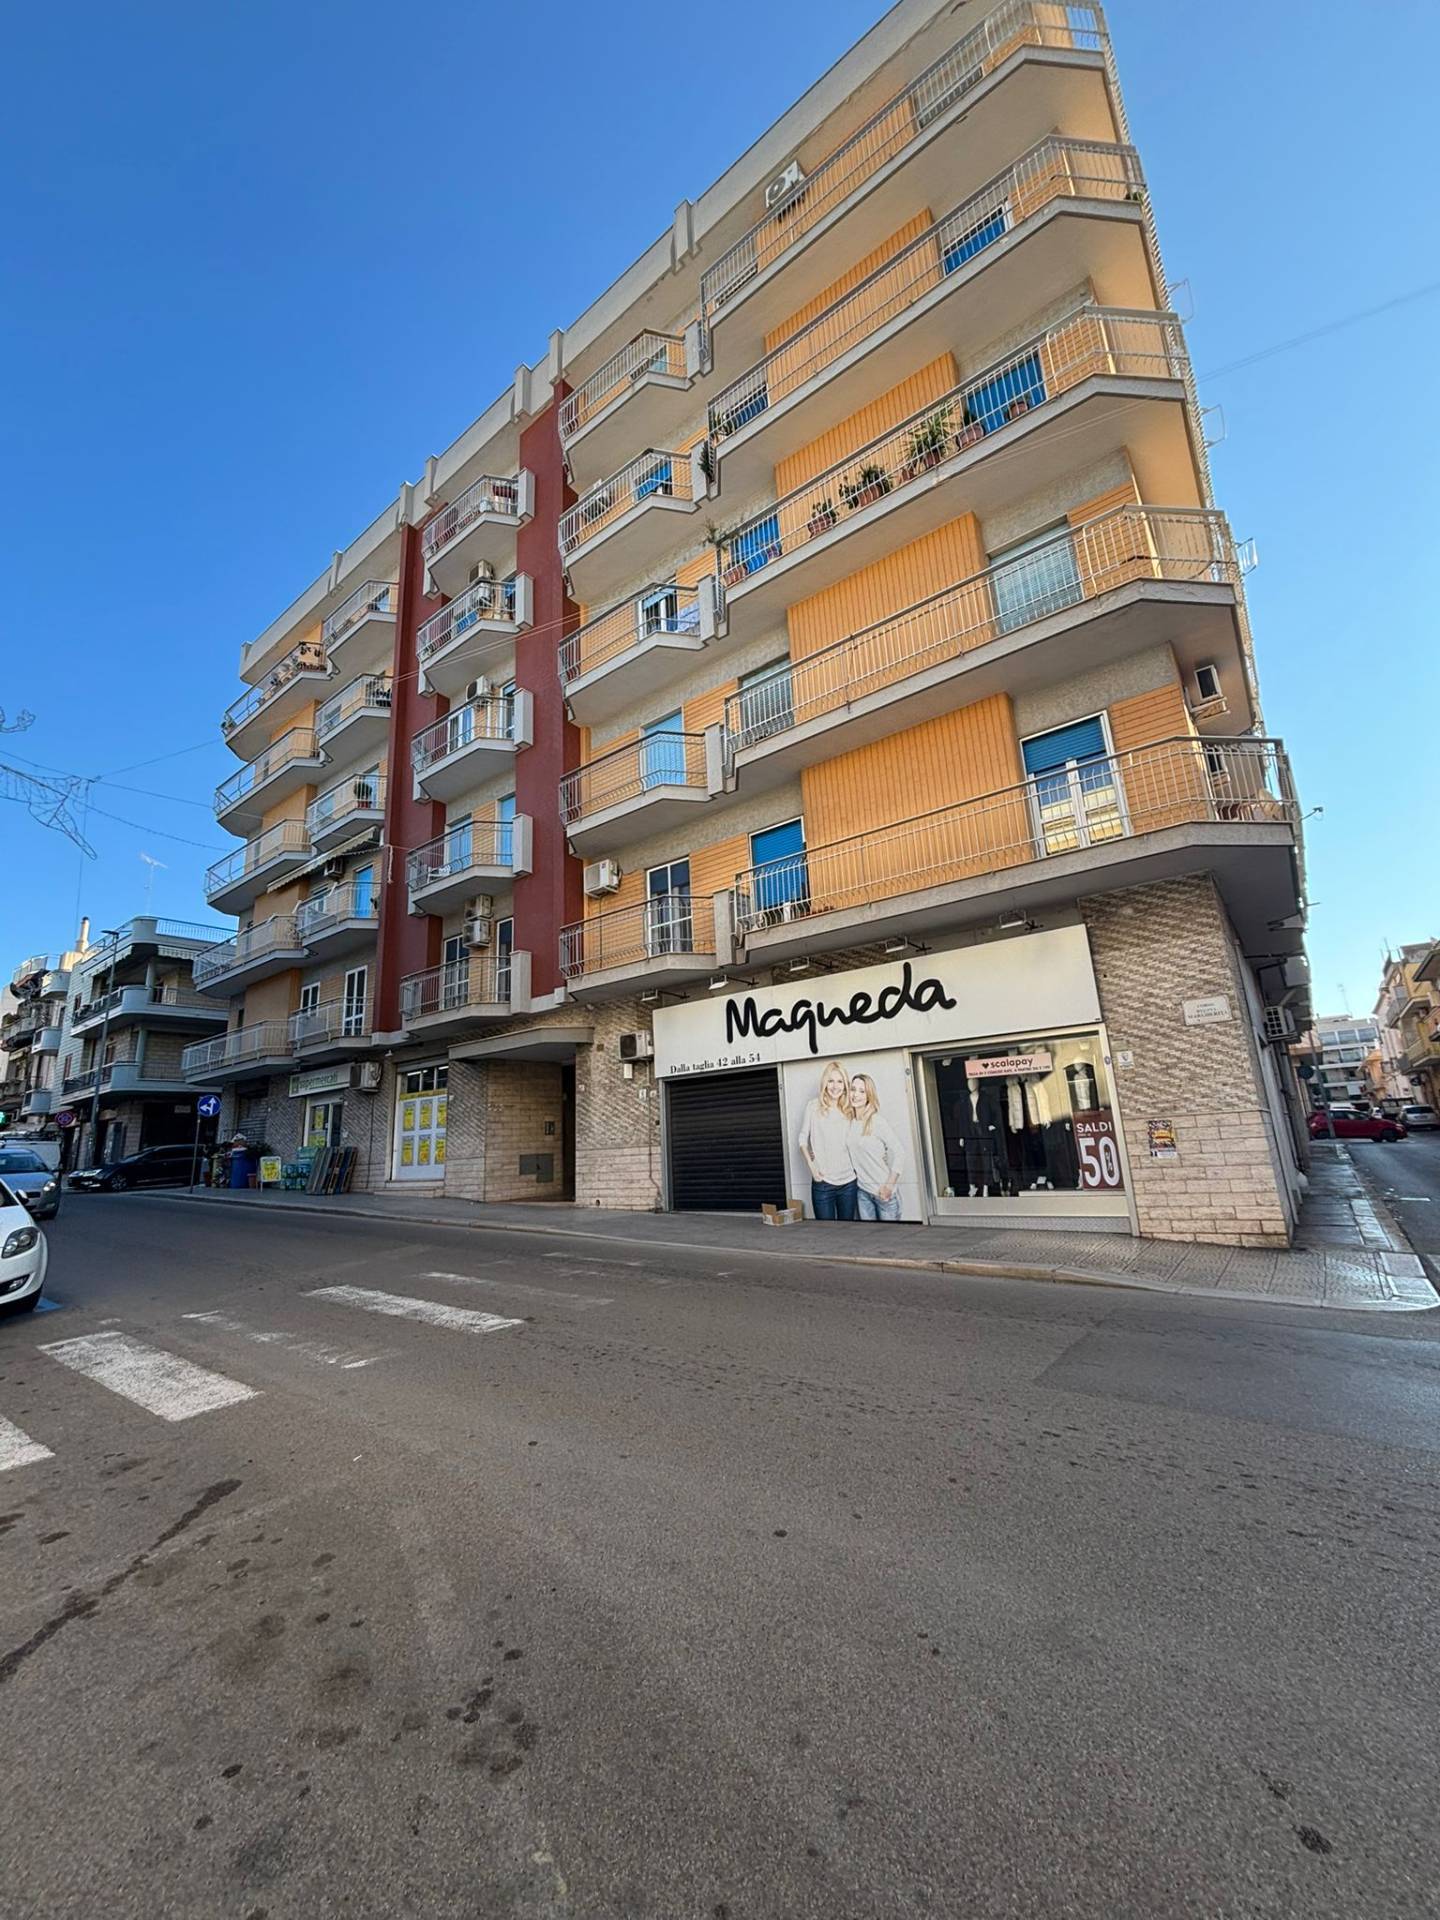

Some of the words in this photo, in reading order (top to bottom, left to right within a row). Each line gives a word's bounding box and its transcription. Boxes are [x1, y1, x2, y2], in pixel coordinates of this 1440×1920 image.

[726, 962, 957, 1054] Maqueda
[670, 1063, 691, 1074] Dalla
[692, 1060, 715, 1072] taglia
[717, 1057, 728, 1067] 42
[731, 1055, 746, 1066] alla
[749, 1052, 760, 1063] 54
[990, 1058, 1034, 1069] scalapay
[1076, 1121, 1113, 1133] SALDI
